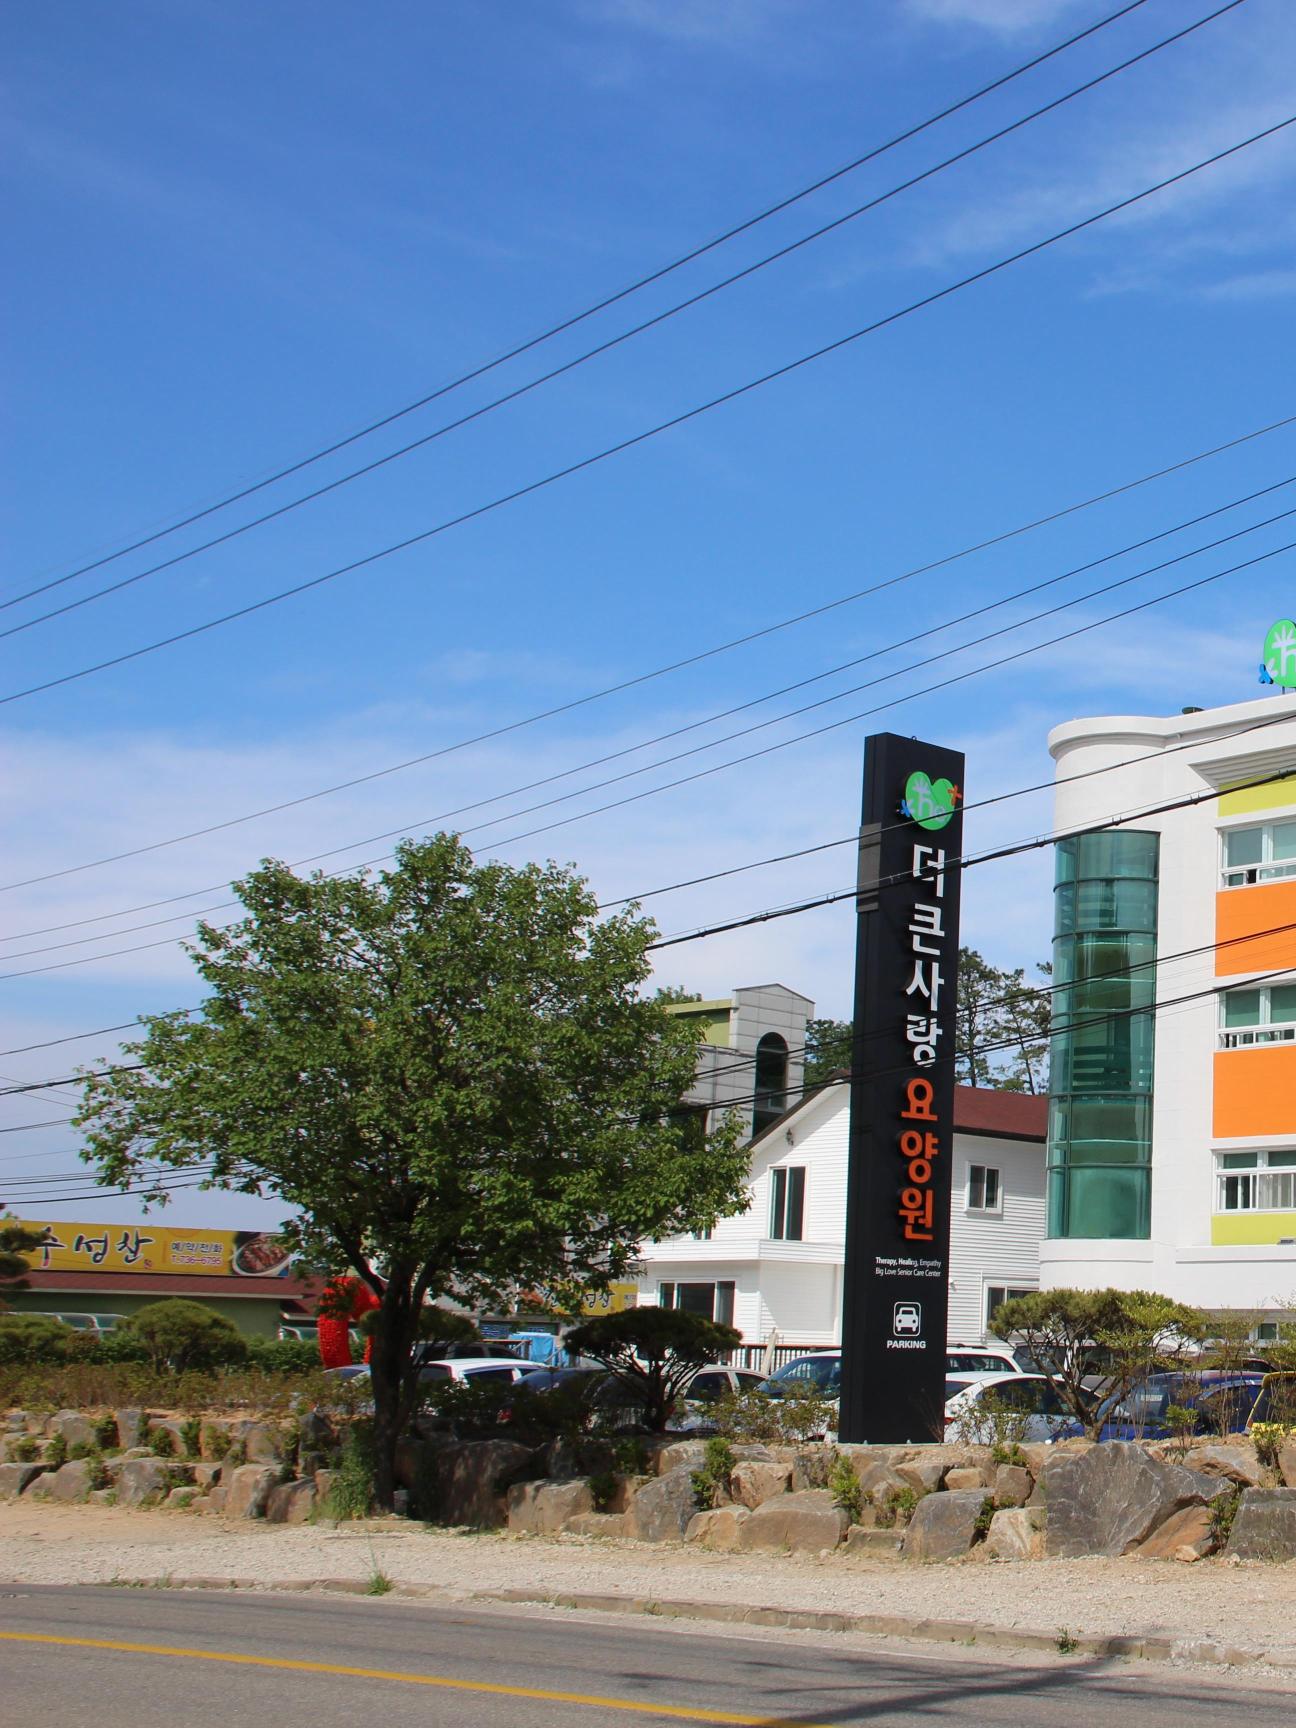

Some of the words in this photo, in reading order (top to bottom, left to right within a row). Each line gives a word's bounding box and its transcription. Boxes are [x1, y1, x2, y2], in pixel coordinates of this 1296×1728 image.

[899, 1078, 939, 1241] 요양원
[875, 1256, 898, 1266] Therapy,
[898, 1257, 919, 1267] Healing,
[920, 1259, 941, 1268] Empathy
[875, 1268, 884, 1276] Big
[897, 1268, 912, 1276] Senior
[925, 1269, 941, 1277] Center
[887, 1340, 926, 1349] PARKING
